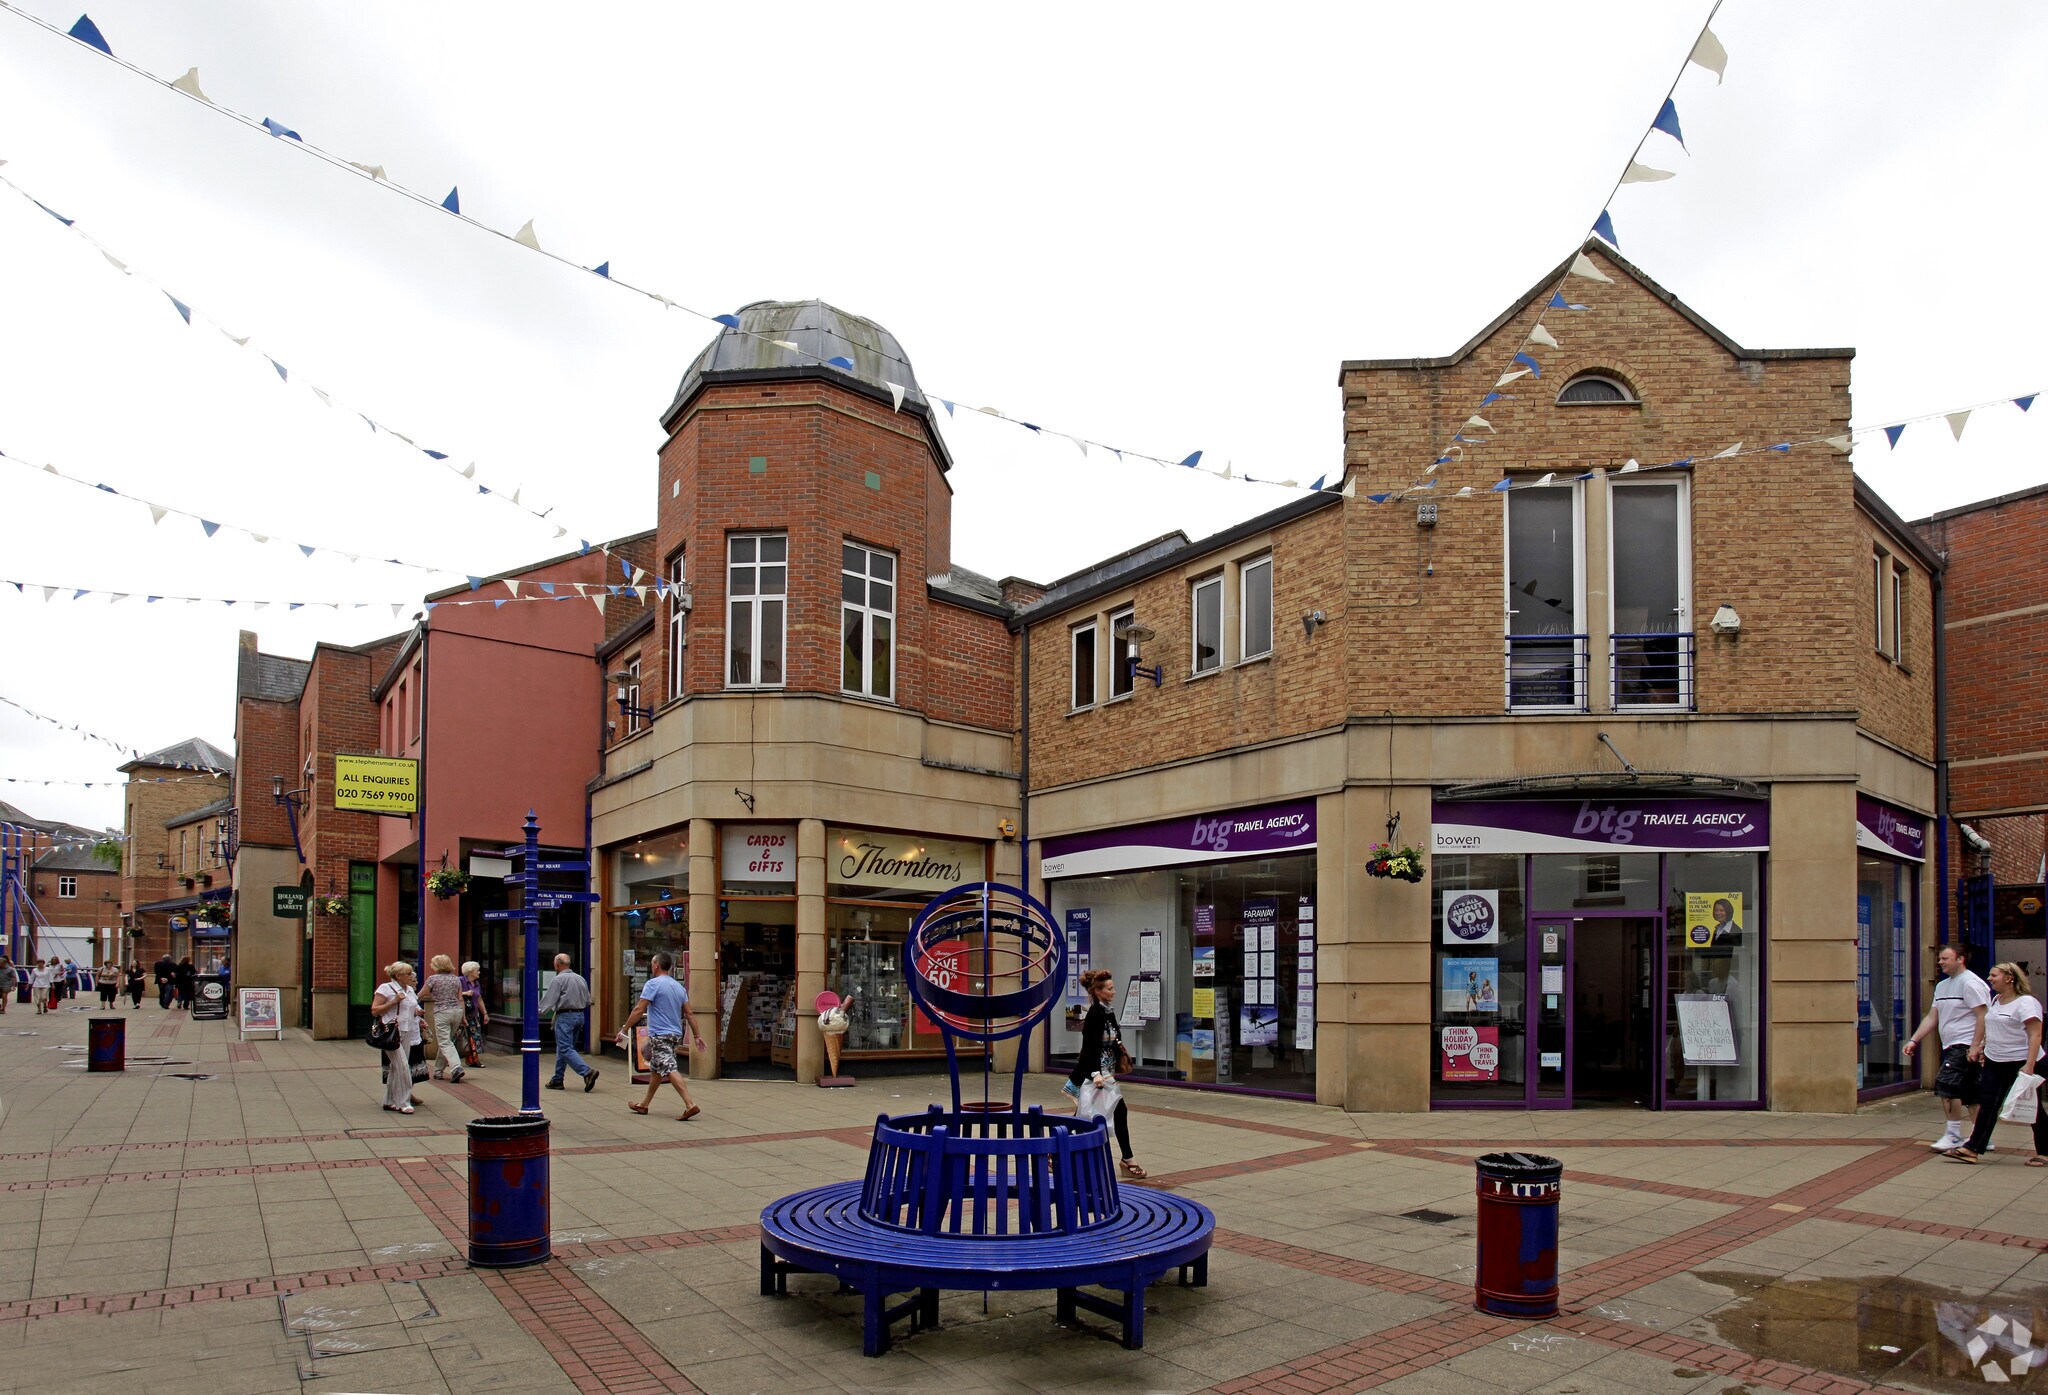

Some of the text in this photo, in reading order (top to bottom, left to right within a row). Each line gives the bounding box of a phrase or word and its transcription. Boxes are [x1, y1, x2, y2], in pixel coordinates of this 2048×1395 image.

[343, 774, 410, 785] ALL ENQUIRIES
[337, 788, 415, 802] 020 7569 9900
[1572, 799, 1746, 844] btg TRAVEL AGENCY
[1878, 806, 1897, 847] btg
[1908, 827, 1921, 839] AGENCY
[1190, 813, 1304, 852] btg TRAVEL AGENCY
[747, 835, 786, 847] CARDS
[1437, 833, 1481, 845] bowen
[761, 848, 771, 860] &
[749, 861, 784, 873] GIFTS
[839, 843, 962, 882] Thorntons
[1044, 862, 1065, 872] bowen
[1243, 908, 1275, 919] FARAWAY
[1452, 901, 1483, 917] ABOUT
[1450, 907, 1489, 928] YOU
[1460, 922, 1489, 937] @btg
[927, 958, 958, 970] SAVE
[1712, 994, 1726, 1003] btg
[1445, 1043, 1472, 1051] MONEY
[1494, 1181, 1560, 1197] LITTE
